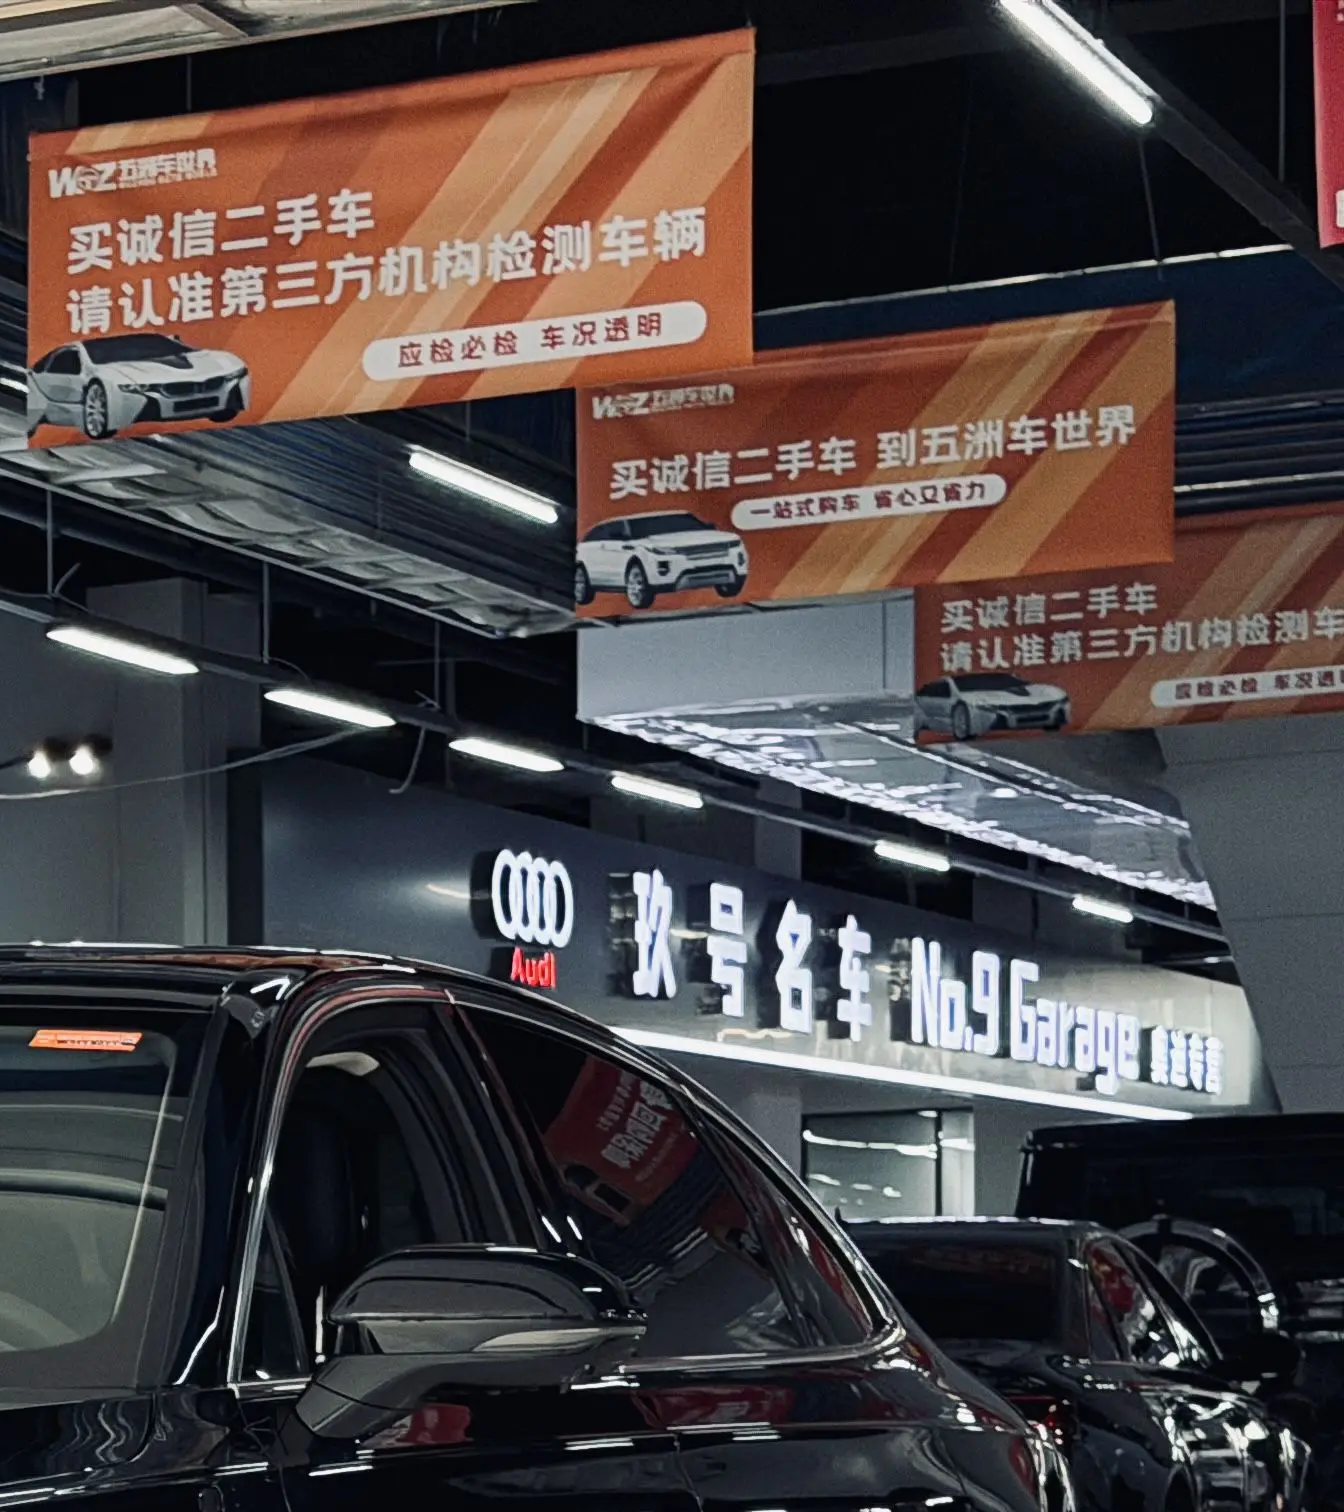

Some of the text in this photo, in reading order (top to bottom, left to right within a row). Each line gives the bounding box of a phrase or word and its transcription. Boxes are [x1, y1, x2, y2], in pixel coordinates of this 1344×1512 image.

[66, 206, 706, 334] 请认准第三方机构检测车辆
[67, 188, 375, 275] 买诚信二手车
[540, 312, 661, 350] 车况透明
[609, 404, 1137, 500] 买诚信二手车 到五洲车世界
[940, 582, 1157, 633] 买诚信二手车
[510, 946, 556, 988] Audi
[633, 868, 872, 1042] 玖号名车
[911, 937, 1000, 1056] No.9
[1011, 959, 1140, 1095] Garage
